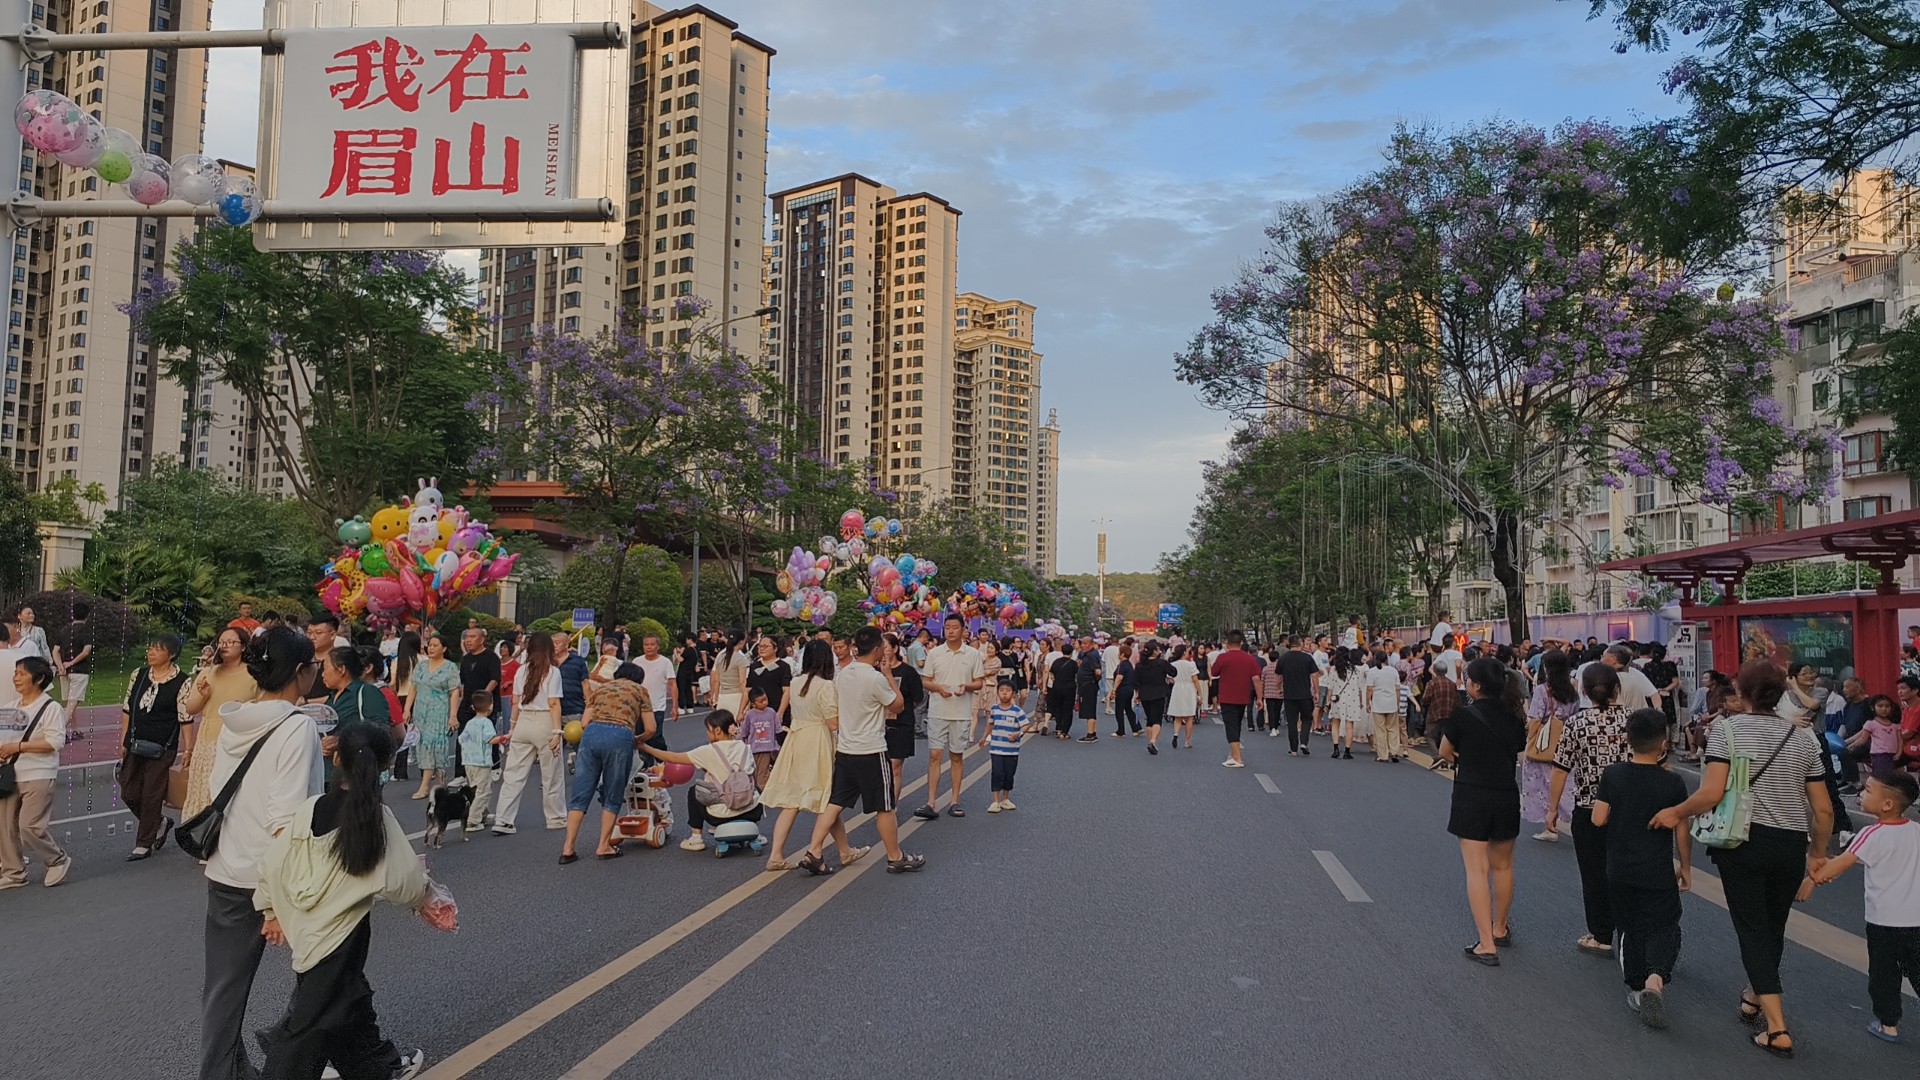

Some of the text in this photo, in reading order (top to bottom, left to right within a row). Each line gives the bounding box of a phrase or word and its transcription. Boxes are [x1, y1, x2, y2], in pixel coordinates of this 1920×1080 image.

[325, 33, 531, 113] 我在
[320, 121, 520, 199] 眉山
[545, 123, 559, 197] MEISHAN
